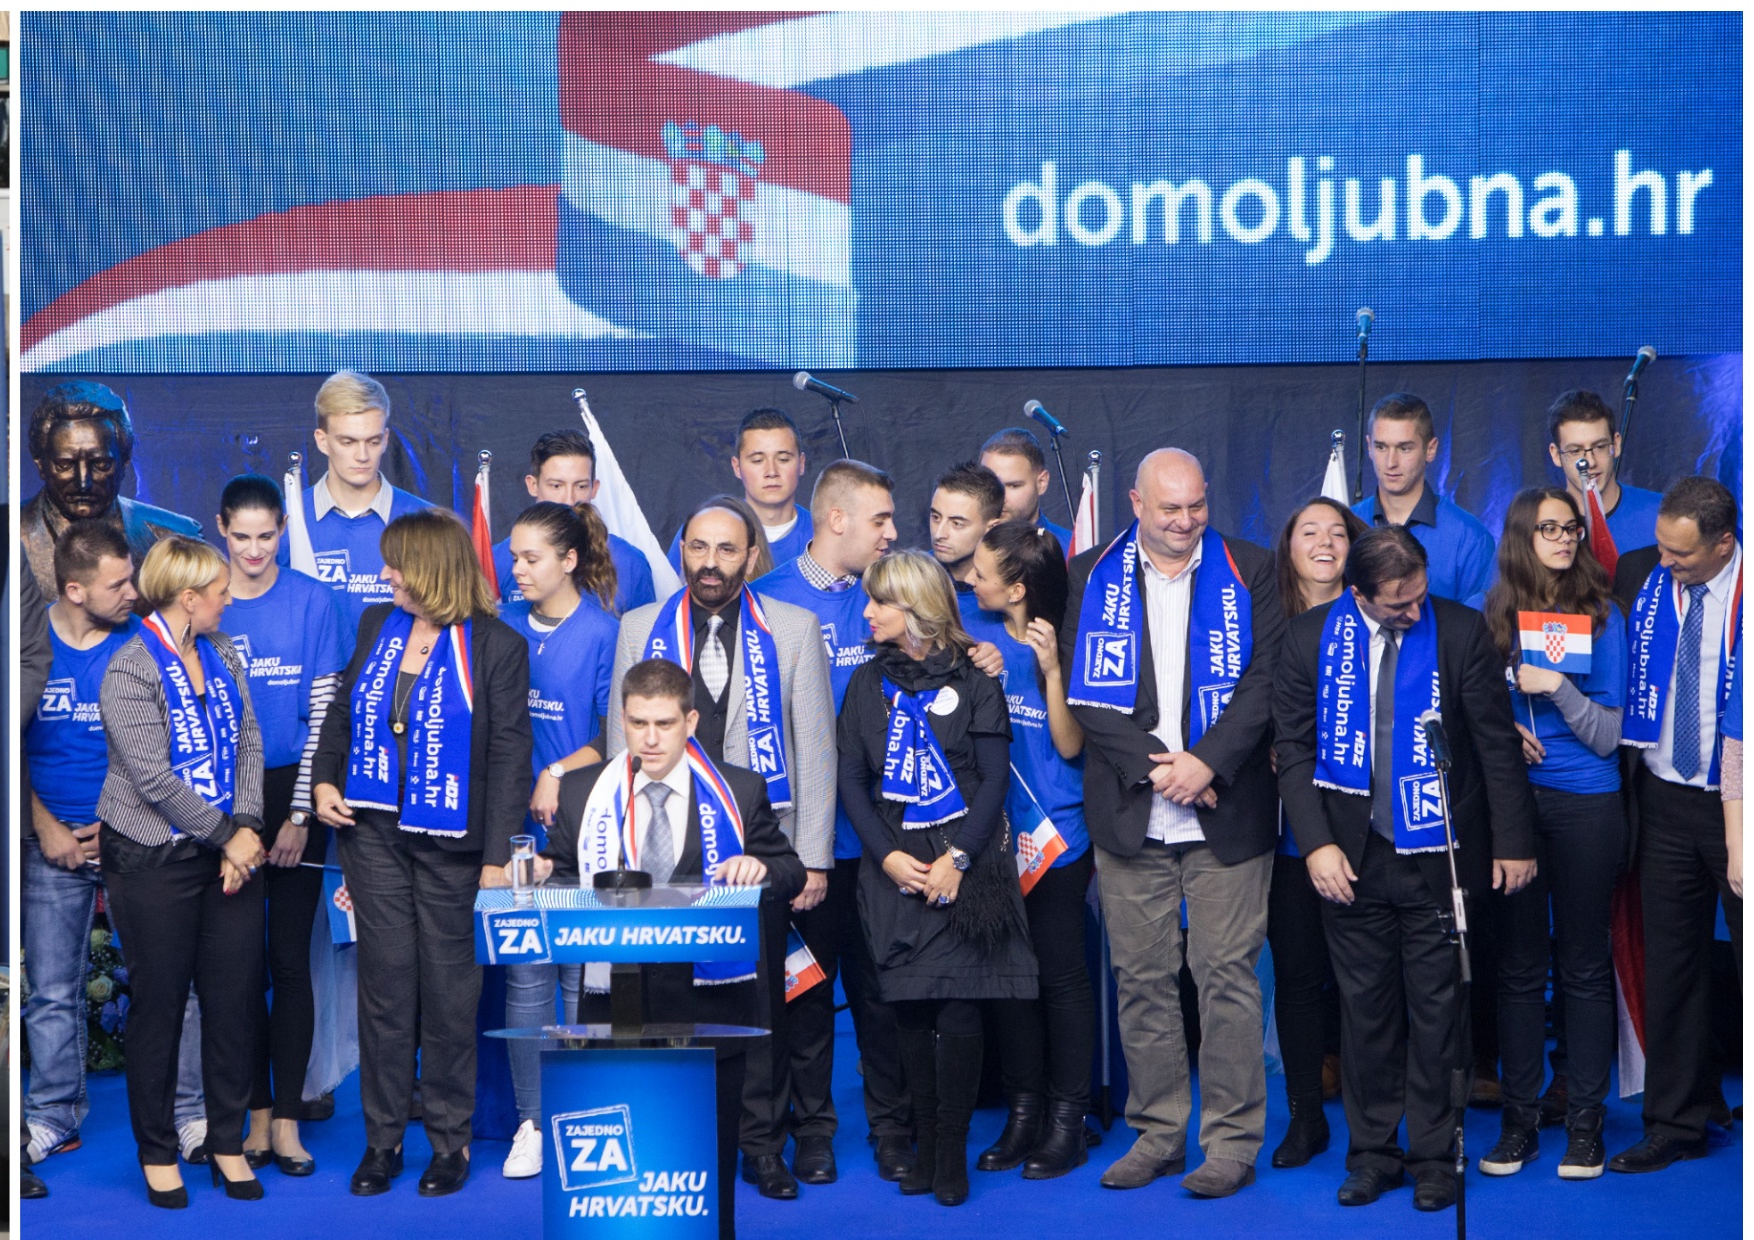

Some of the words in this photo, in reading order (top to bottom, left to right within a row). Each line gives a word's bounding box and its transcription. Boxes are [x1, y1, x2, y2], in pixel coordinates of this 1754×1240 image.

[1002, 149, 1713, 265] domoljubna.hr
[318, 565, 347, 582] ZA
[347, 583, 393, 594] HRVATSK
[349, 574, 378, 584] JAKU
[1117, 540, 1137, 630] HRVATSKU.
[1102, 583, 1120, 626] JAKU
[1221, 583, 1241, 678] HRVATSKU.
[250, 657, 281, 668] JAKU
[837, 646, 865, 657] JAKU
[1093, 637, 1105, 679] ZAJEDNO
[1102, 638, 1128, 678] ZA
[1209, 630, 1225, 677] JAKU
[746, 629, 770, 723] HRVATSKU.
[1333, 614, 1358, 765] domoljubna.hr
[42, 695, 72, 712] ZA
[72, 712, 100, 722] HRVA
[165, 661, 209, 751] HRVATSKU.
[363, 637, 404, 779] domoljubna.hr
[528, 698, 565, 711] VATSKU.
[1007, 704, 1047, 720] VATSKU.
[1210, 691, 1219, 727] AJEDNO
[1648, 684, 1659, 721] HDZ
[171, 709, 193, 754] JAKU
[1352, 730, 1366, 768] HDZ
[378, 746, 389, 784] HDZ
[749, 737, 760, 773] AJEDNO
[757, 733, 777, 772] ZA
[192, 759, 218, 798] ZA
[445, 773, 458, 810] HDZ
[1413, 781, 1421, 821] ZAJEDNO
[1422, 779, 1443, 817] ZA
[494, 918, 539, 928] ZAJEDNO
[498, 929, 543, 954] ZA
[554, 927, 616, 946] JAKU
[621, 925, 746, 945] HRVATSKU.
[566, 1124, 623, 1137] ZAJEDNO
[571, 1139, 628, 1172] ZA
[638, 1171, 707, 1193] JAKU
[569, 1196, 709, 1217] HRVATSKU.
